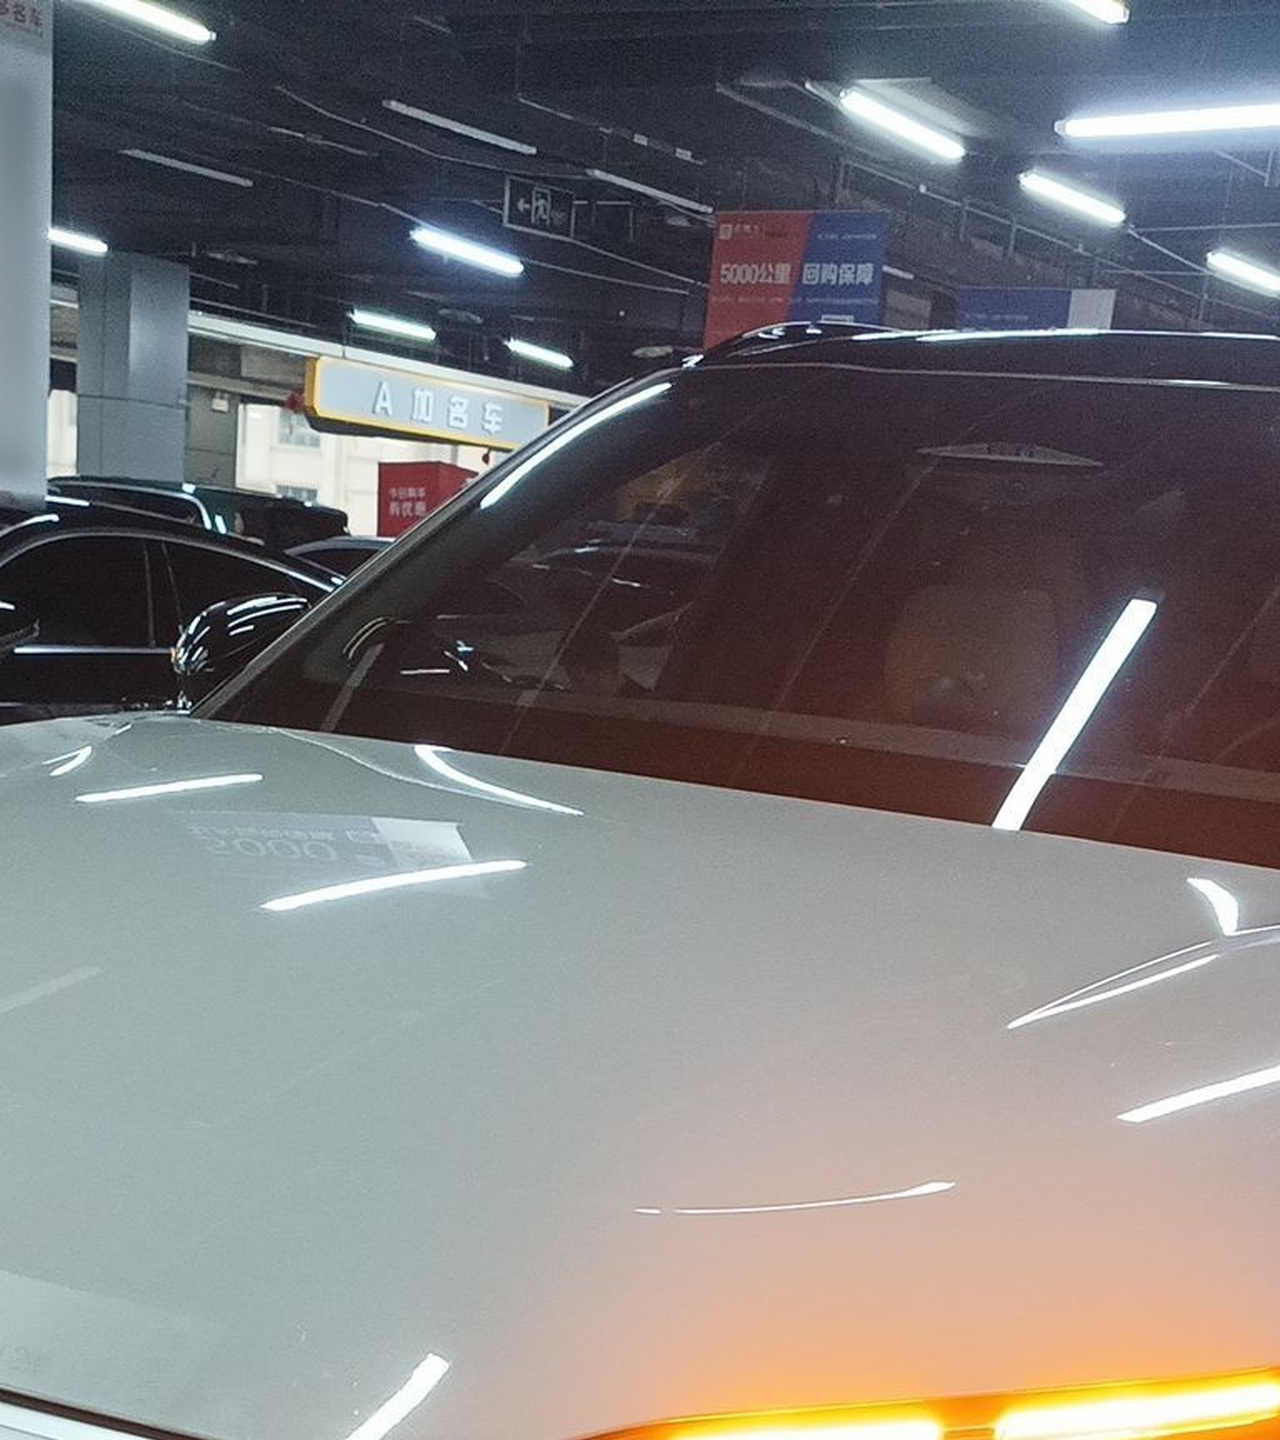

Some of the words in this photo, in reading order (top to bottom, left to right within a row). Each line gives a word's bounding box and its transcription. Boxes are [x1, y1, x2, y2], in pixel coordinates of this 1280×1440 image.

[720, 263, 791, 285] 5000公里
[802, 262, 875, 286] 回购保障
